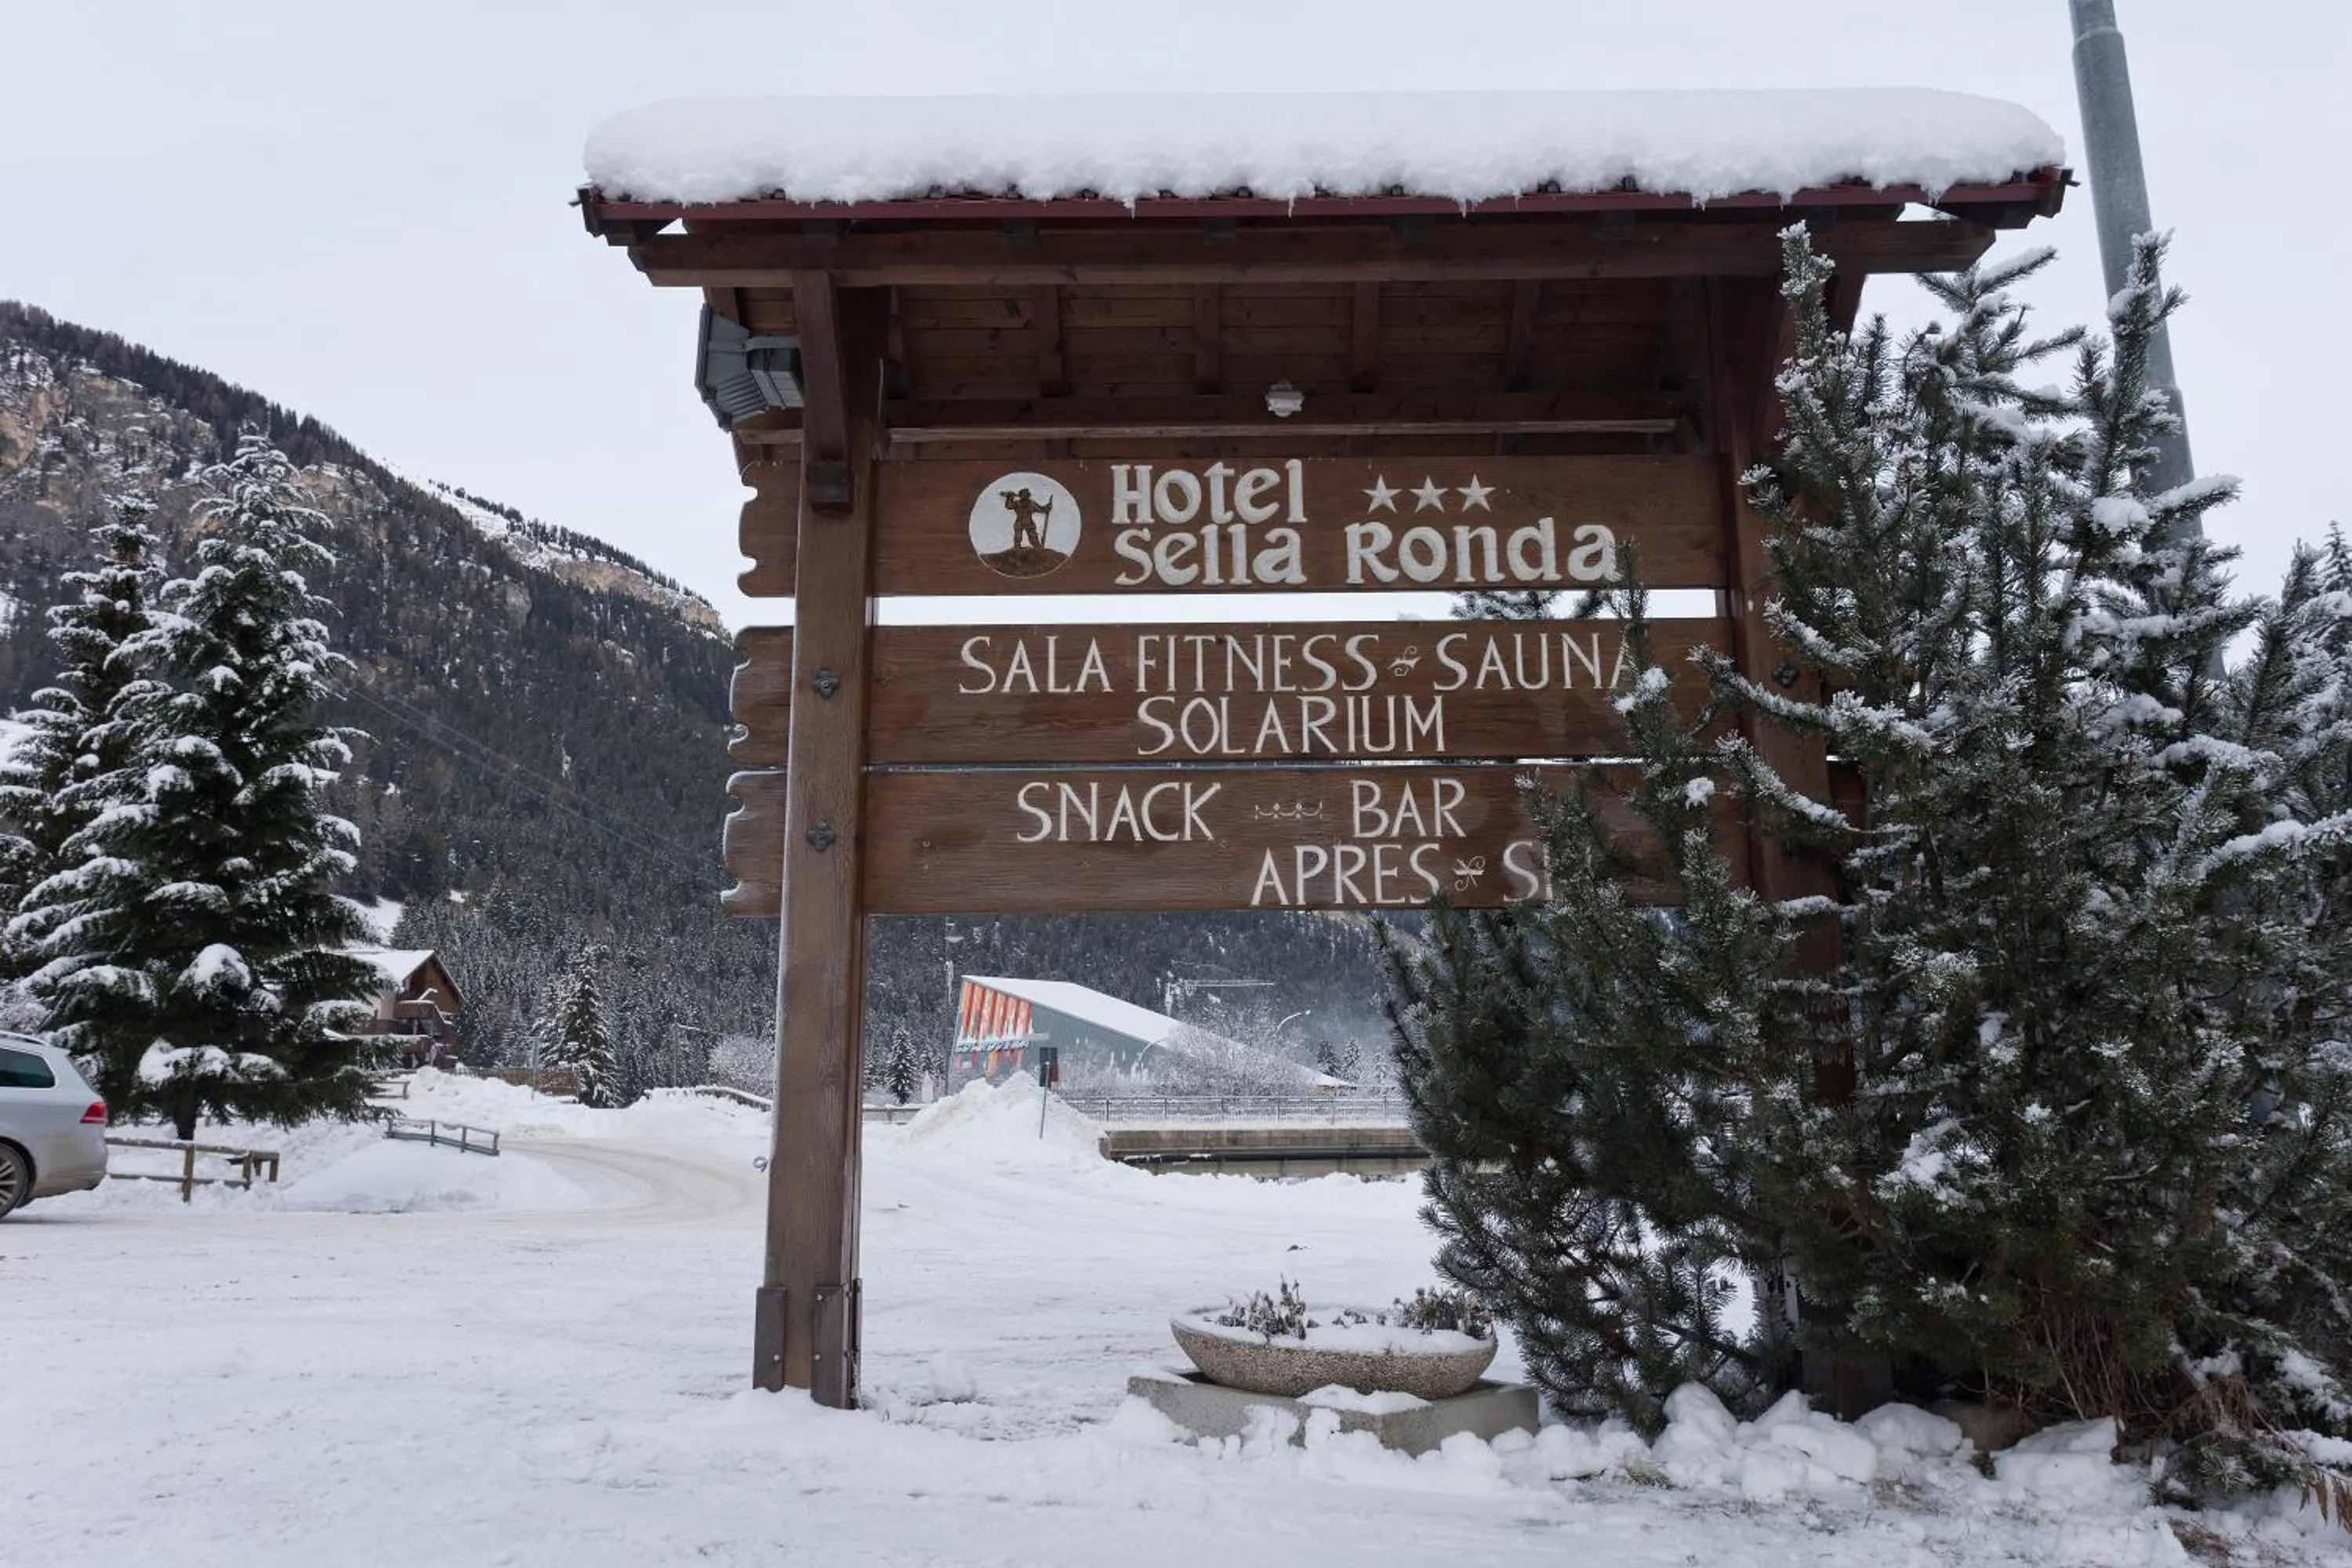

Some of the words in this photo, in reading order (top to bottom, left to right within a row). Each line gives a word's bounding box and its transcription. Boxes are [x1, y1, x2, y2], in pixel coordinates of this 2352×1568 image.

[1111, 459, 1308, 524] Hotel
[1114, 523, 1308, 586] Sella
[1344, 517, 1621, 585] Ronda
[959, 635, 1113, 695] SALA
[1136, 634, 1380, 693] FITNESS
[1138, 695, 1446, 756] SOLARIUM
[1016, 781, 1221, 844] SNACK
[1350, 779, 1467, 839] BAR
[1250, 842, 1441, 906] APRES
